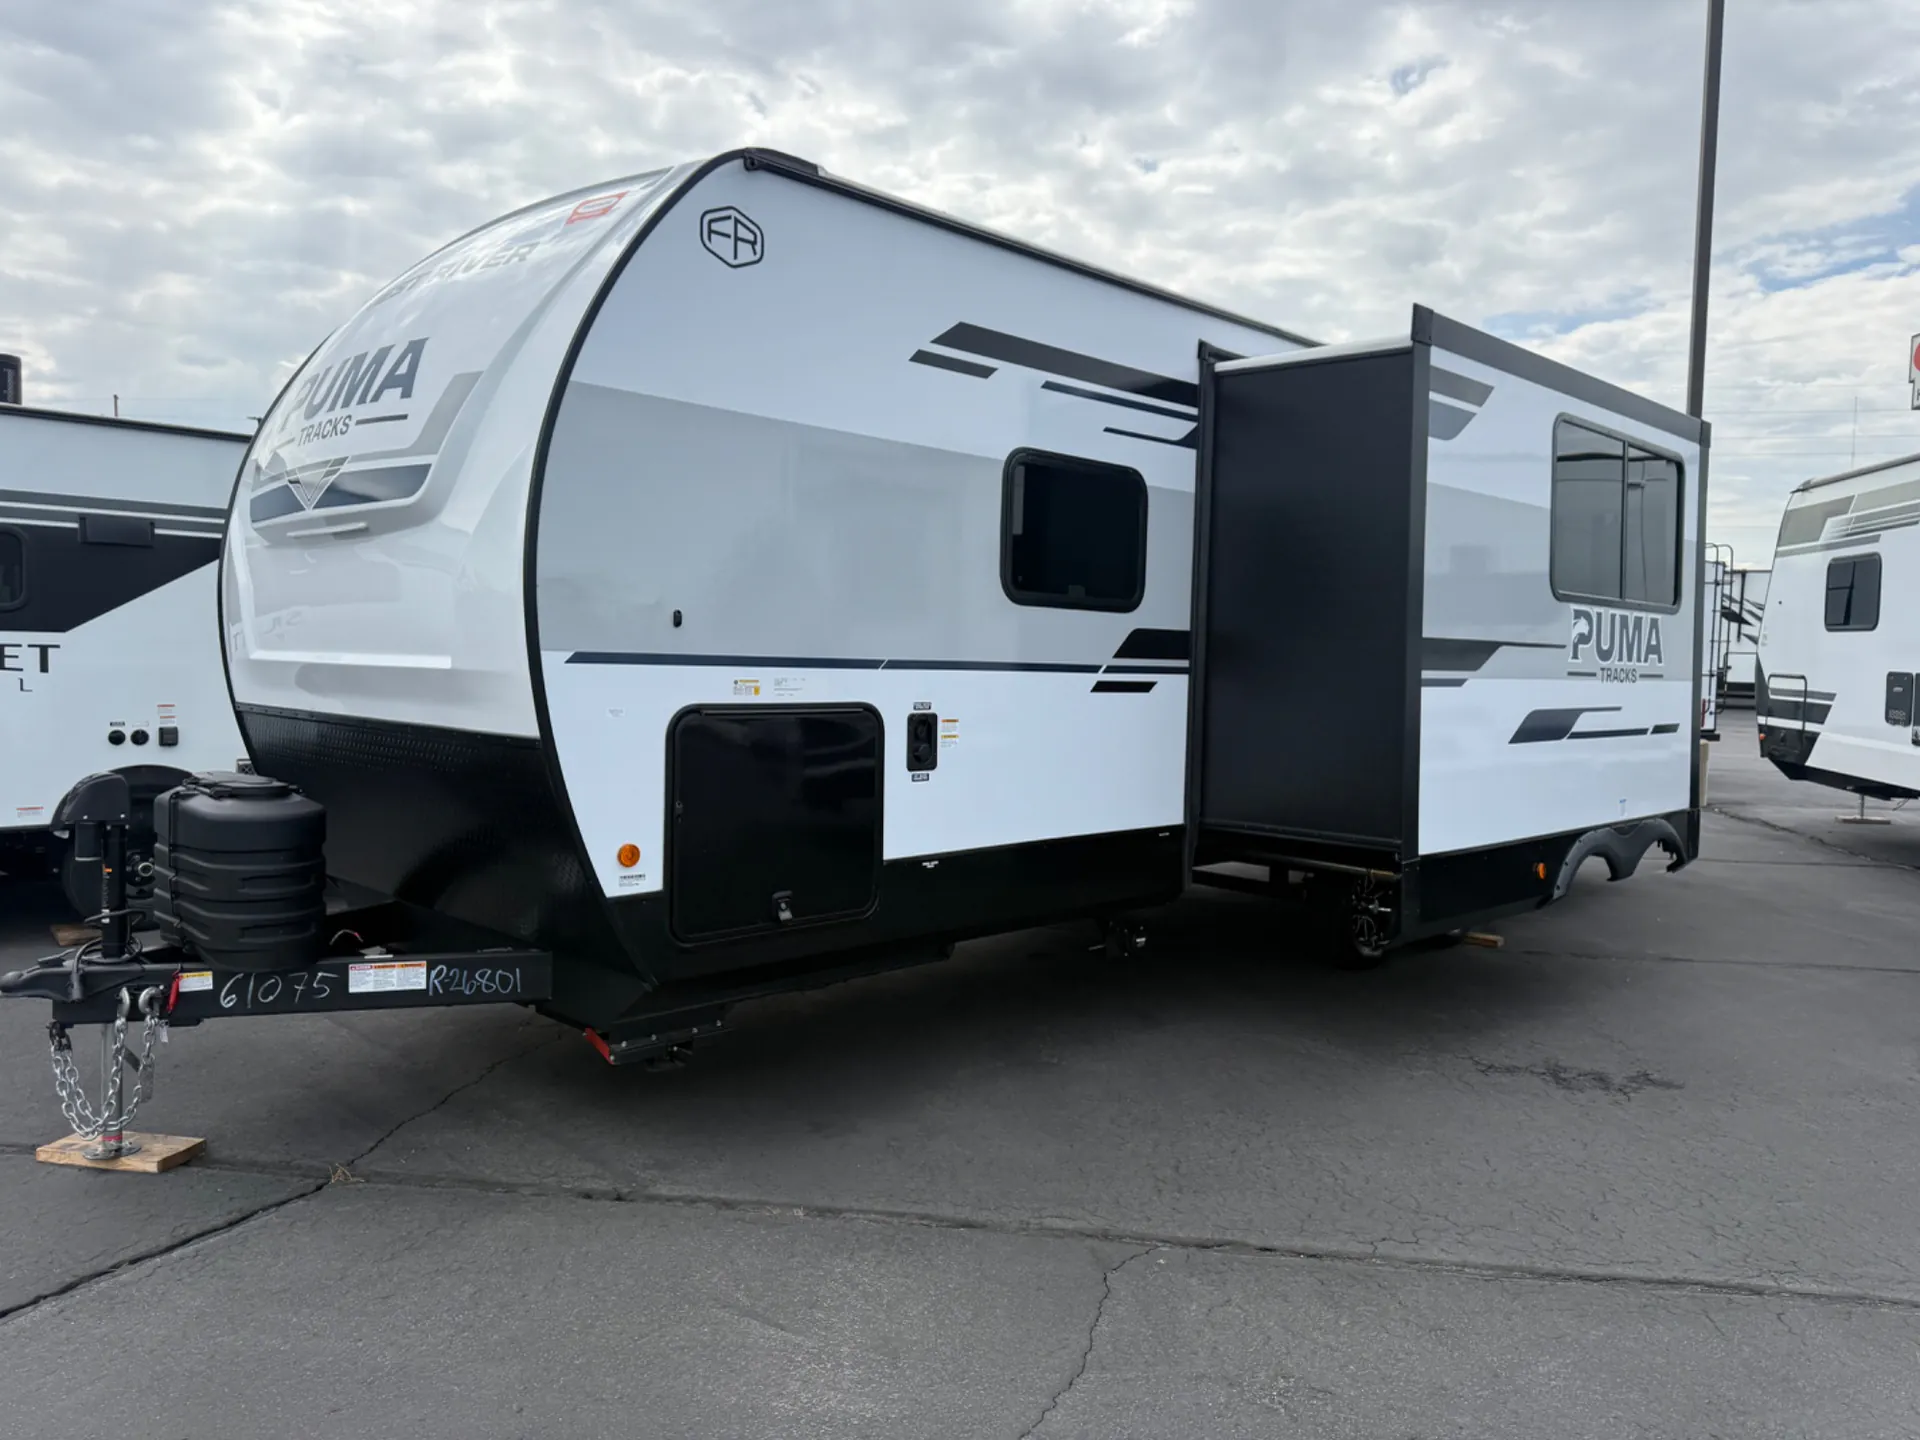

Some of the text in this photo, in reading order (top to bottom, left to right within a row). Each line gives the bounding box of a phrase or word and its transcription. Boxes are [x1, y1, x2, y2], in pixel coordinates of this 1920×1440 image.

[278, 337, 431, 434] PUMA
[298, 414, 352, 446] TRACKS
[1570, 606, 1664, 665] PUMA
[1600, 667, 1637, 683] TRACKS
[220, 971, 339, 1009] 61075
